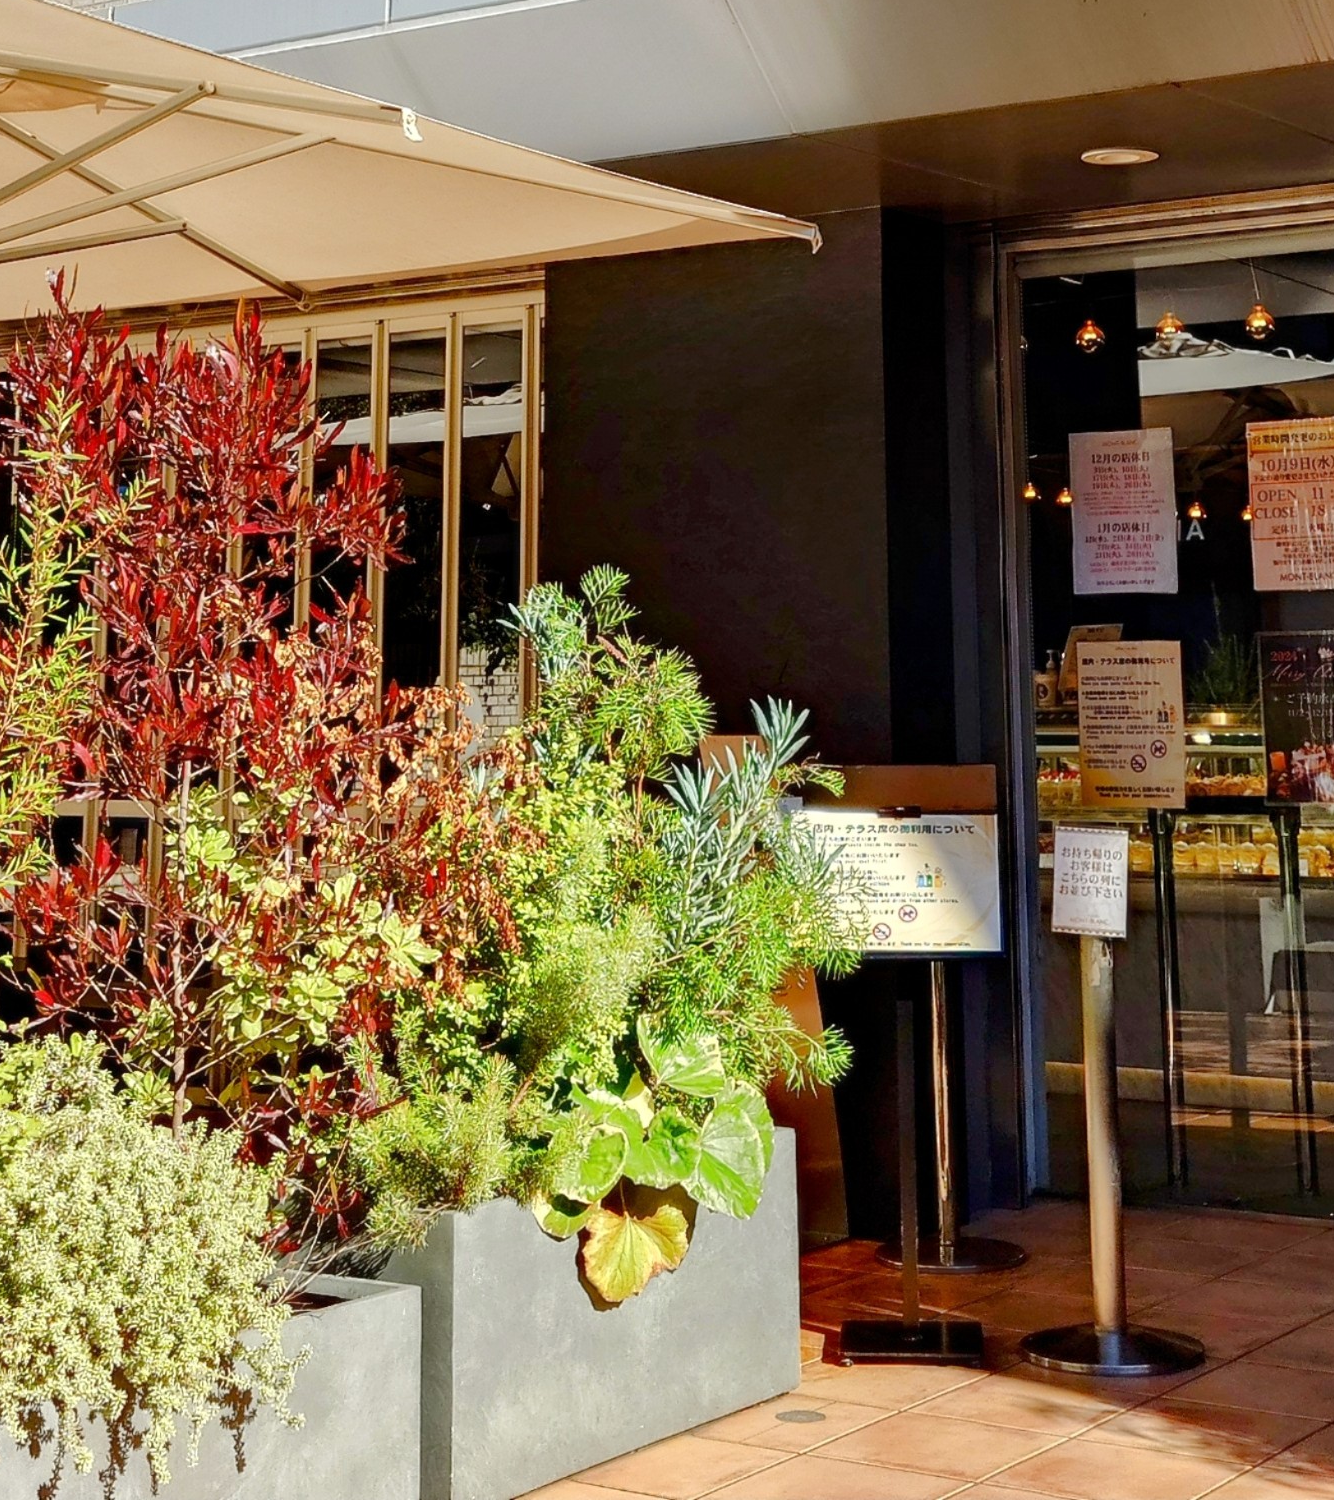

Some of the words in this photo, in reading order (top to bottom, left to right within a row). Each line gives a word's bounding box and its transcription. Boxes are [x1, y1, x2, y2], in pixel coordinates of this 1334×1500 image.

[1257, 488, 1297, 502] OPEN
[1254, 506, 1298, 520] CLOSE
[1061, 846, 1123, 861] お持ち帰りの
[1070, 860, 1113, 873] お客様は
[1061, 872, 1121, 886] こちらの列に
[1059, 884, 1123, 899] お並び下さい
